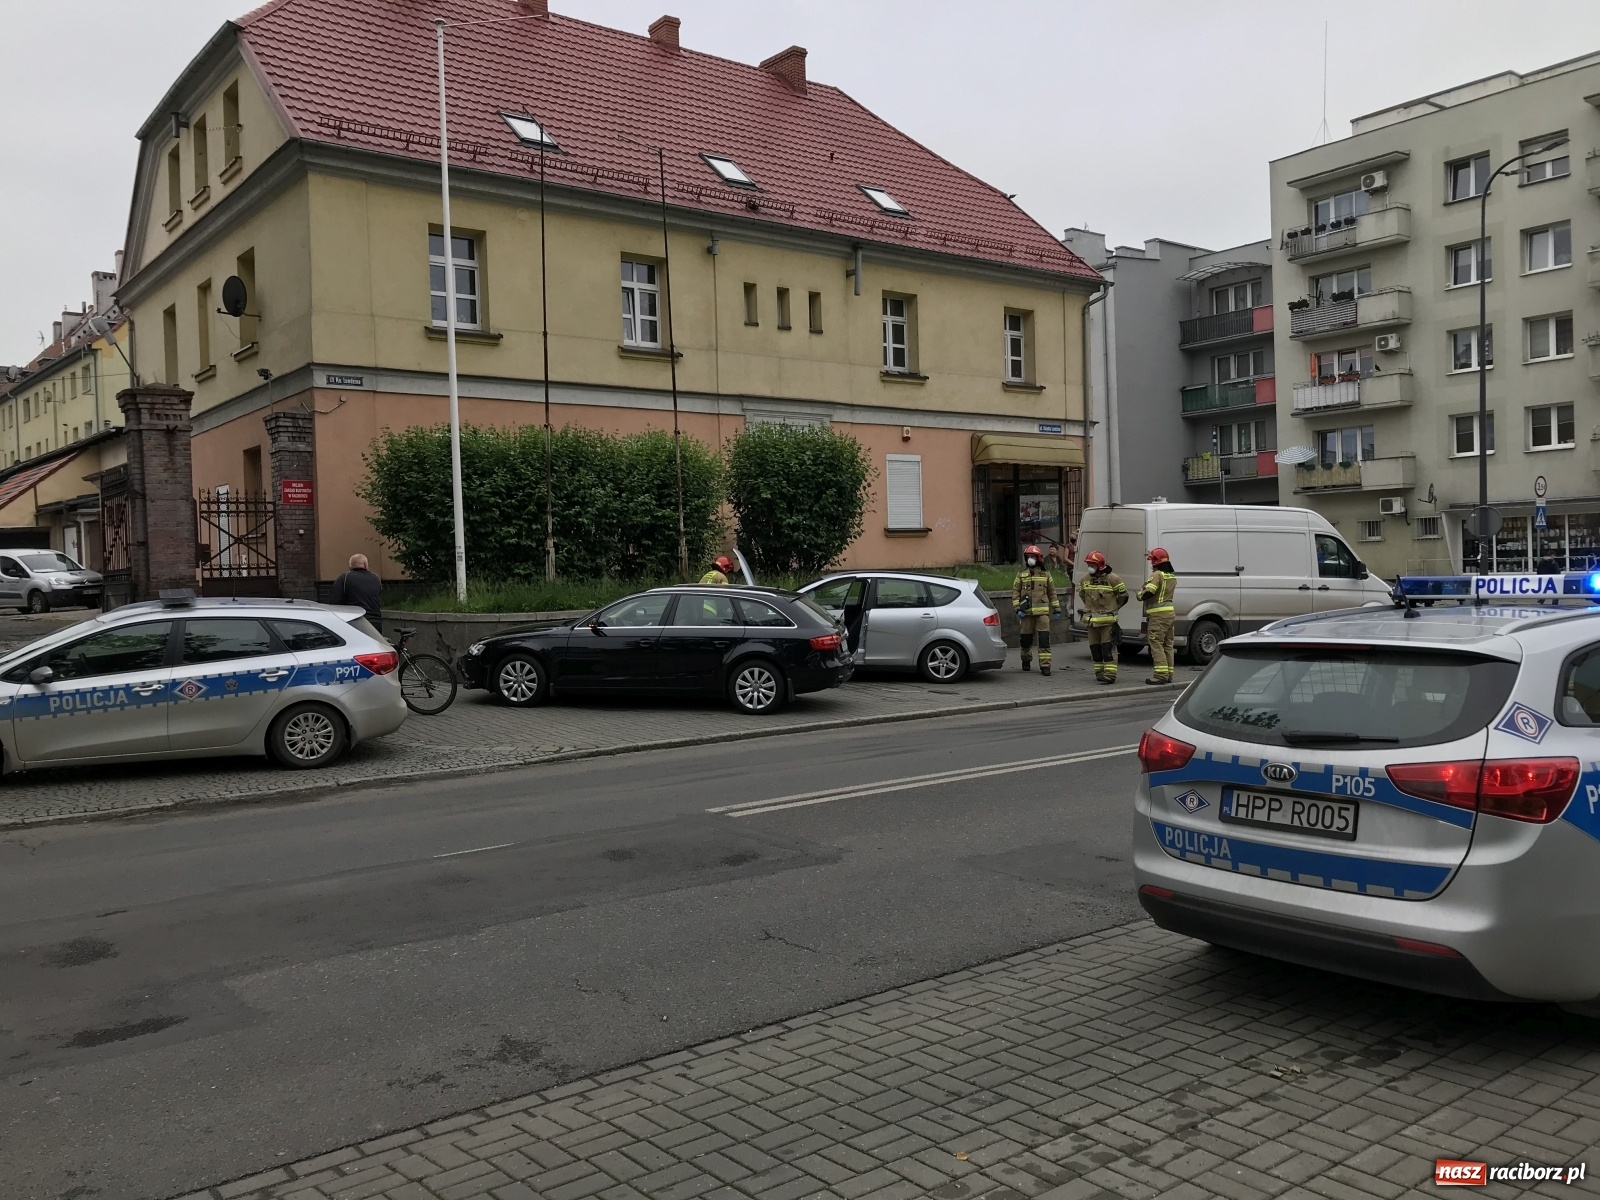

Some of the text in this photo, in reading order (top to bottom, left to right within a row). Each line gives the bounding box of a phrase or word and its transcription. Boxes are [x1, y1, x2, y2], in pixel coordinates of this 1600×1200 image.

[1475, 577, 1558, 595] POLICJA
[335, 665, 360, 679] P917
[50, 690, 128, 712] POLICJA
[1520, 716, 1534, 731] R
[1266, 765, 1291, 780] KIA
[1331, 774, 1376, 797] P105
[1188, 797, 1196, 806] R
[1585, 784, 1600, 814] P
[1222, 806, 1231, 814] PL
[1234, 793, 1350, 832] HPP R005
[1165, 826, 1232, 859] POLICJA
